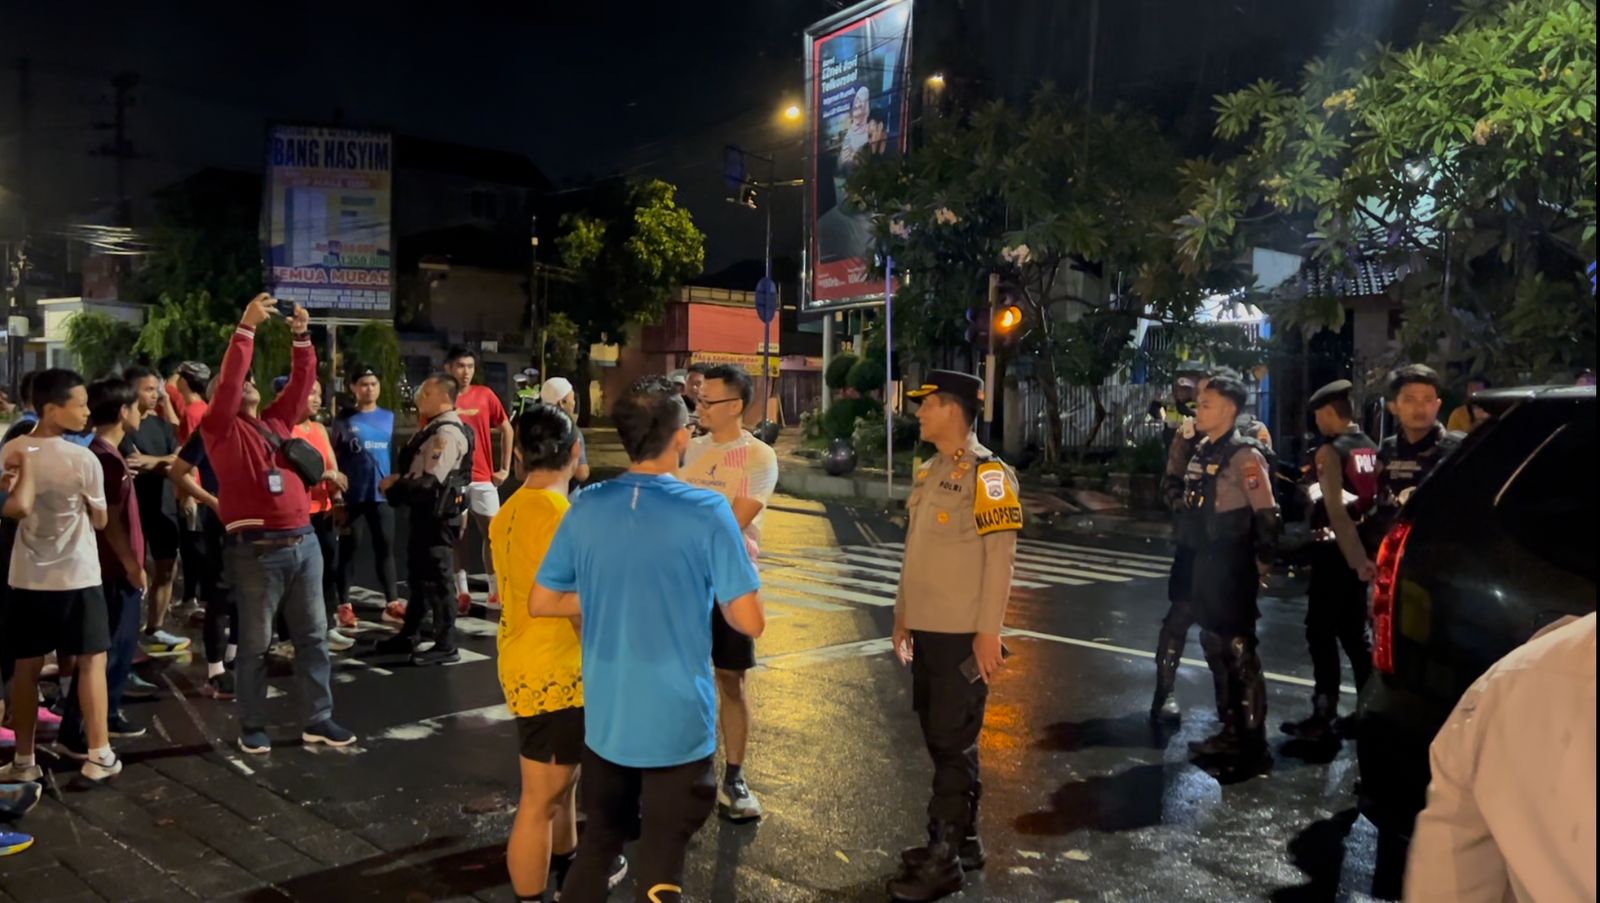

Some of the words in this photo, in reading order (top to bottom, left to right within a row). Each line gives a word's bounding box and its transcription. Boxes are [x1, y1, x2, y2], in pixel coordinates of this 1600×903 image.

[271, 138, 319, 168] BANG
[323, 140, 389, 170] HASYIM
[939, 480, 963, 493] POLRI
